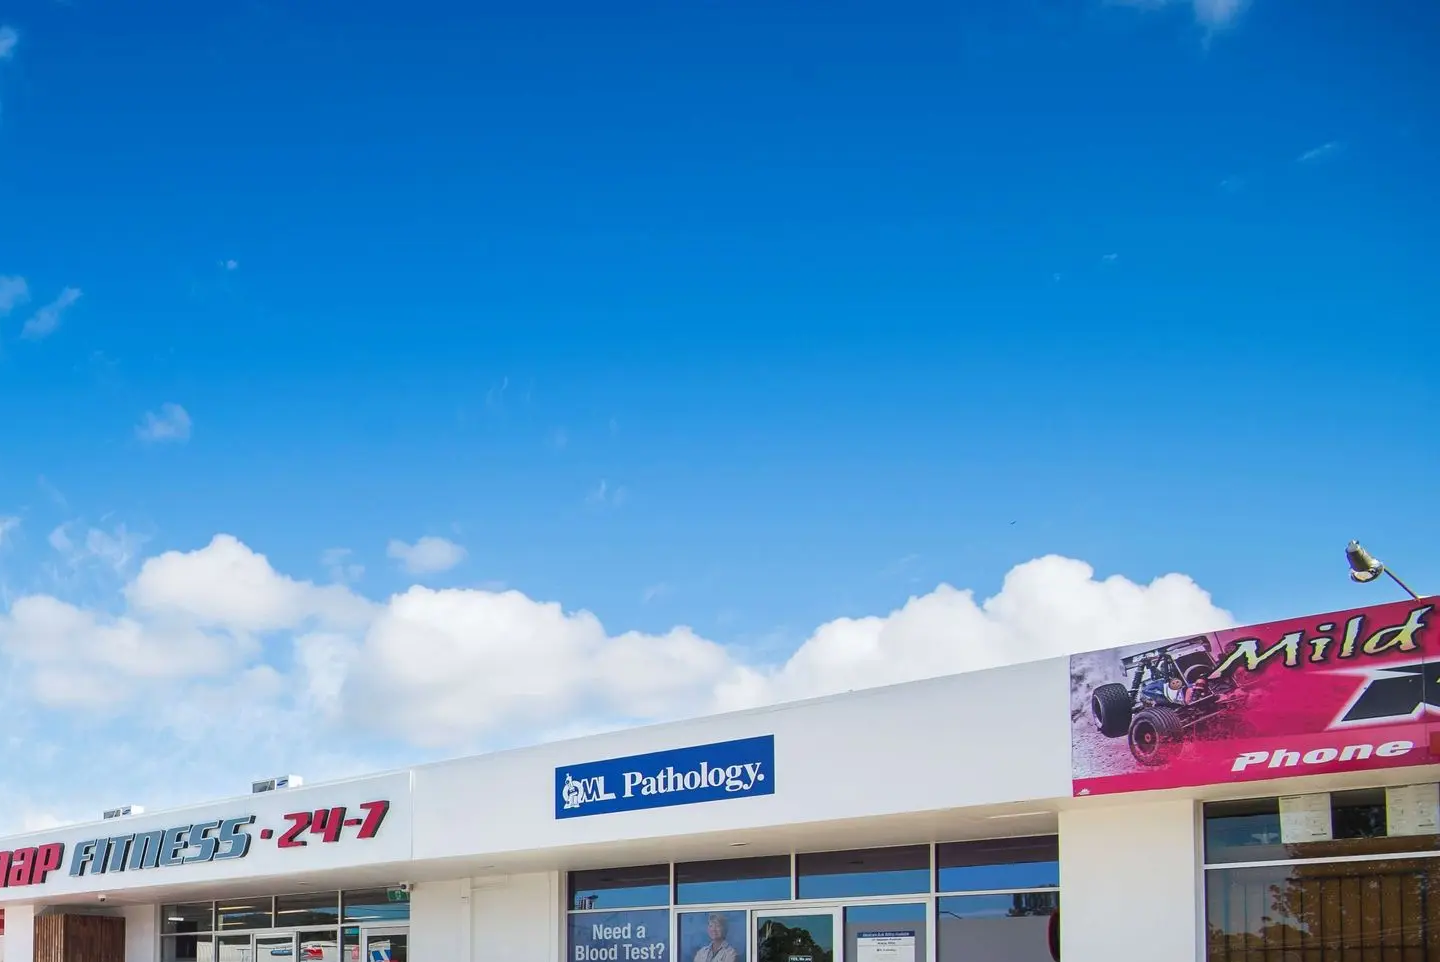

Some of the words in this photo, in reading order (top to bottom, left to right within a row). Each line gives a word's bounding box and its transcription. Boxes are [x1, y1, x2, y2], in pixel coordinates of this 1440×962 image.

[1208, 604, 1436, 681] Mild
[1231, 739, 1415, 772] Phone
[622, 761, 765, 799] Pathology.
[592, 922, 632, 940] Need
[636, 925, 646, 939] a
[575, 945, 618, 961] Blood
[622, 942, 666, 960] Test?
